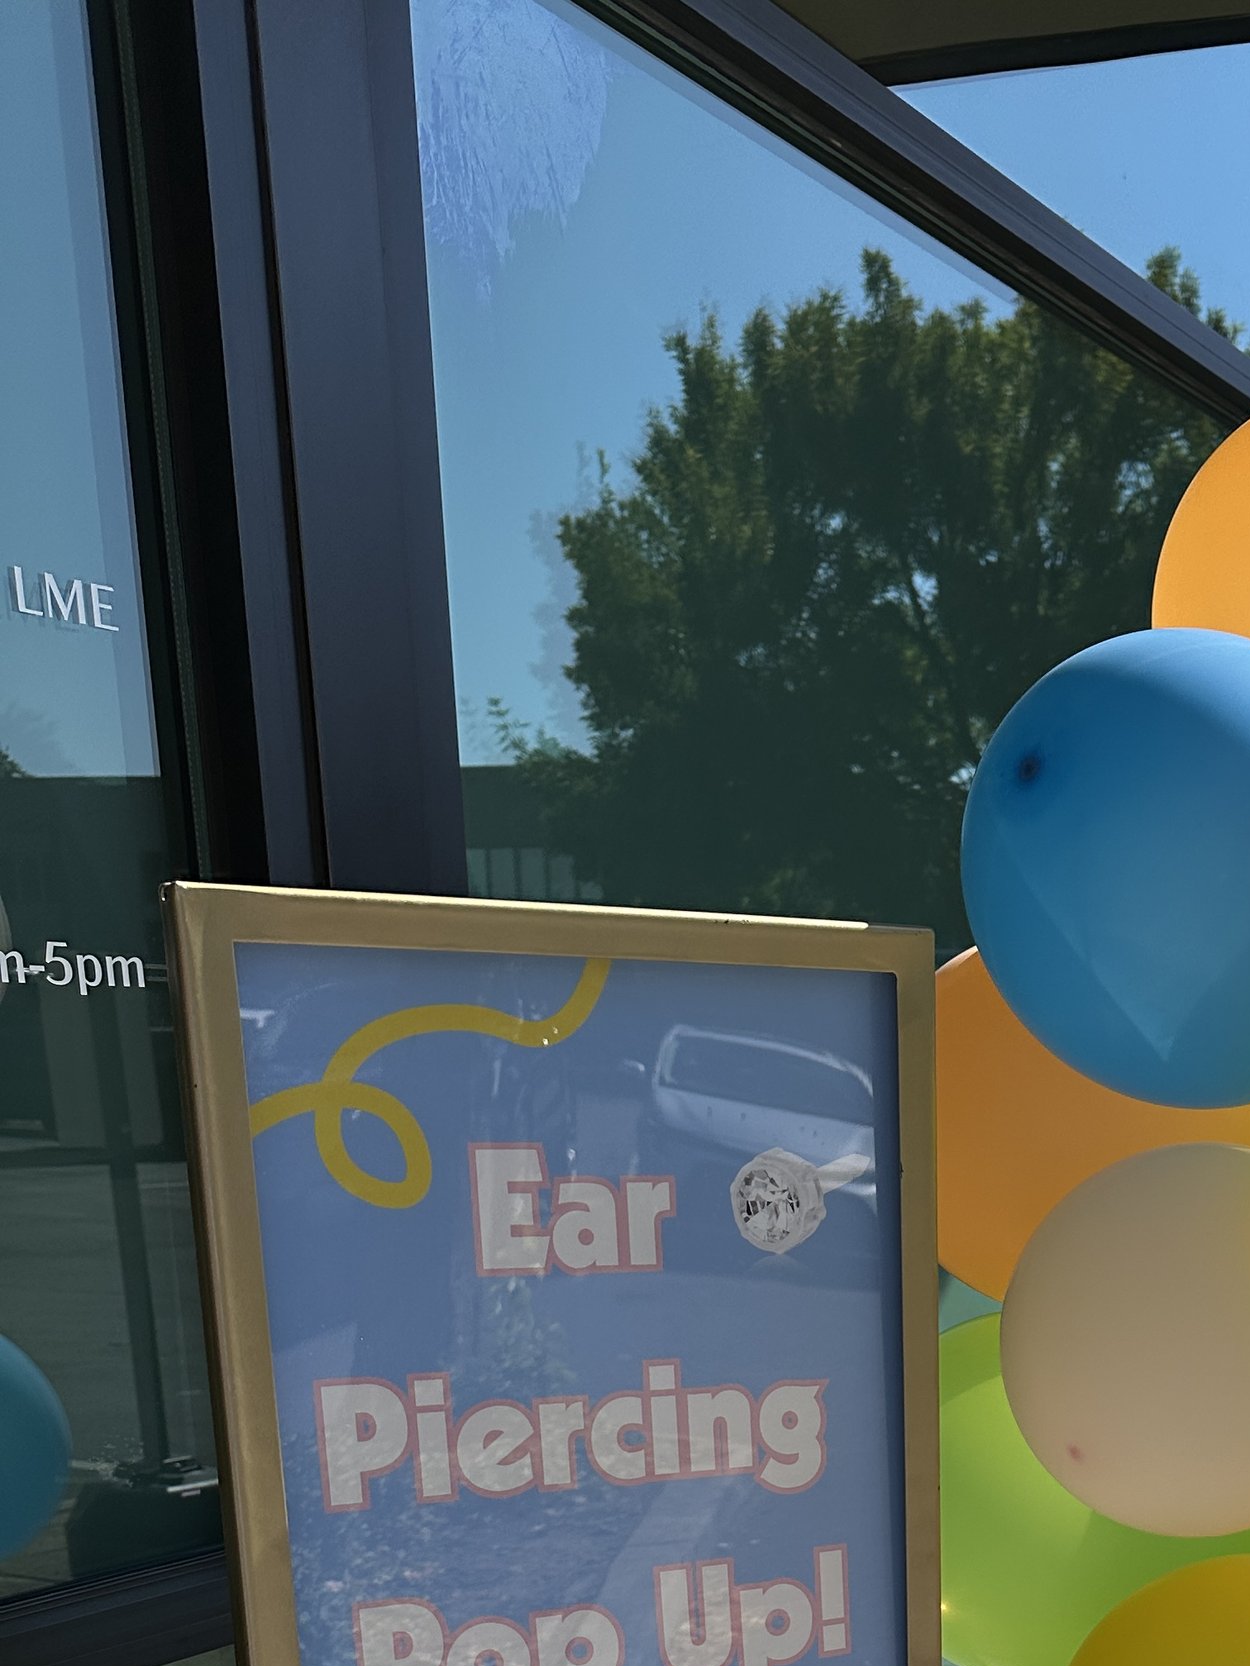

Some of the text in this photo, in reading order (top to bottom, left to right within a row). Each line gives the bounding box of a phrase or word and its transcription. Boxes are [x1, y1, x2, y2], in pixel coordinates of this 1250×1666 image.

[13, 565, 120, 631] LME
[468, 1143, 676, 1277] Ear
[313, 1358, 829, 1513] Piercing
